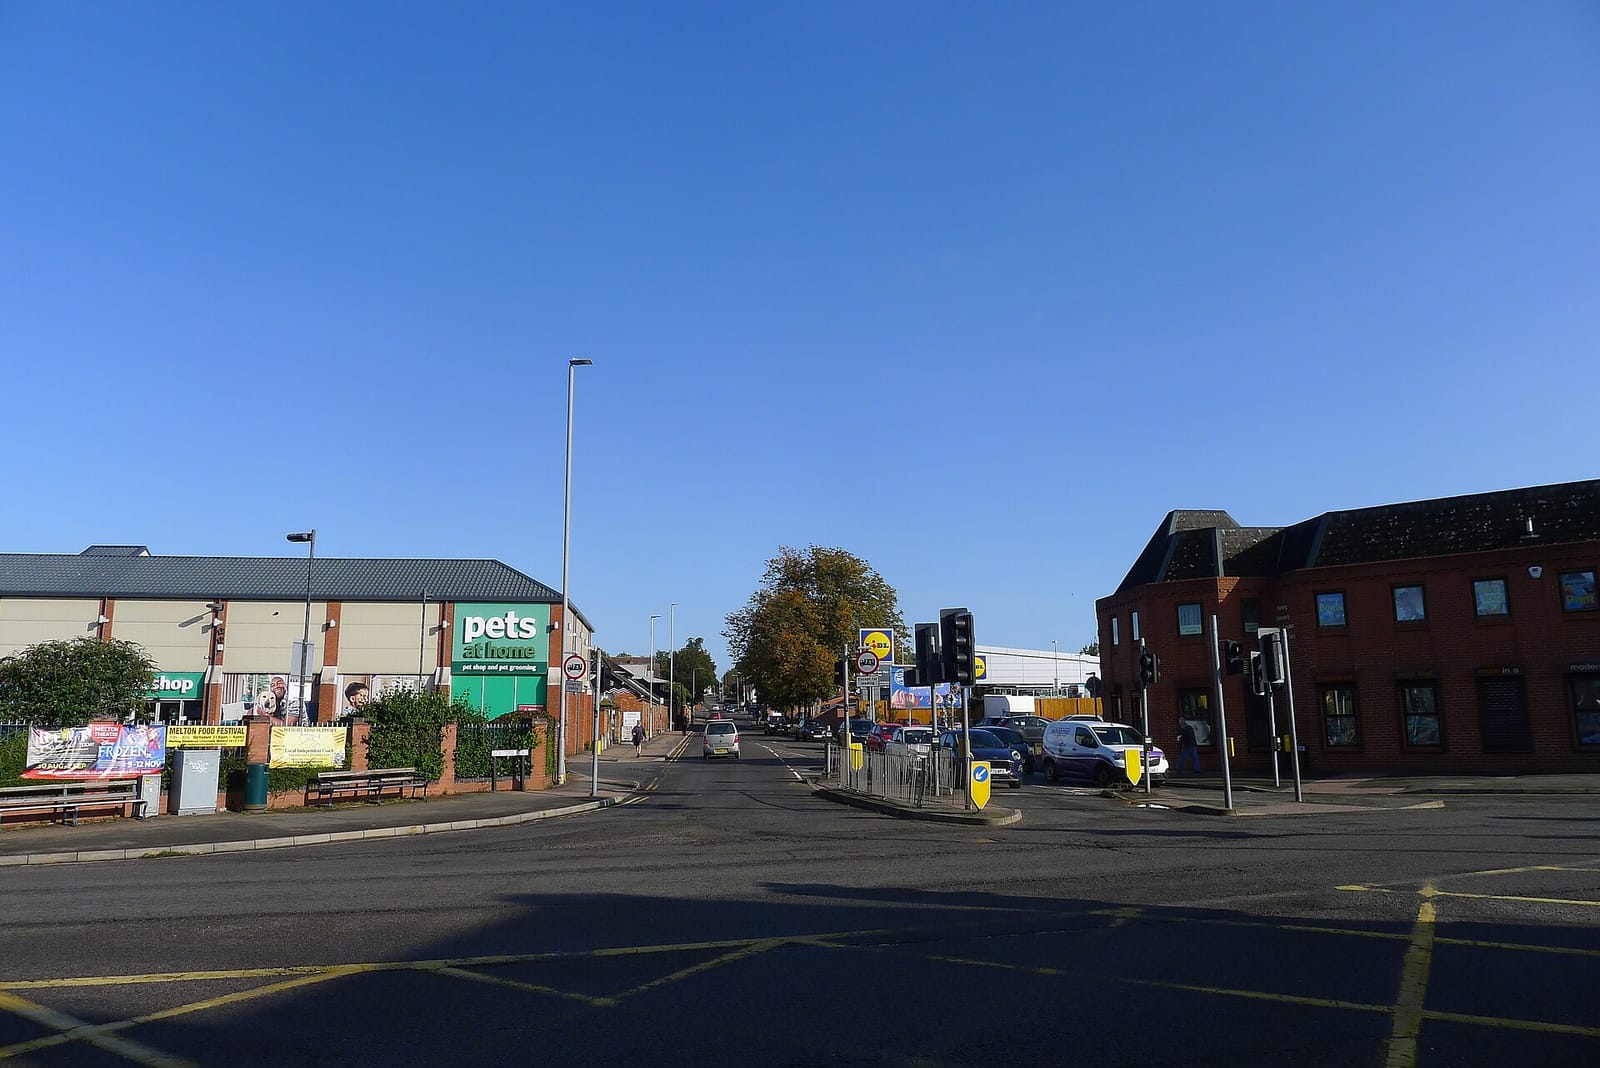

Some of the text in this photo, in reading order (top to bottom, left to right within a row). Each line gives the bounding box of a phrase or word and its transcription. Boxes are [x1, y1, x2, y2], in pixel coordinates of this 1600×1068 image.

[464, 611, 536, 643] pets
[464, 641, 535, 658] at home
[152, 675, 194, 693] shop
[169, 727, 245, 735] MELTON FOOD FESTIVAL
[98, 745, 147, 758] FROZEN
